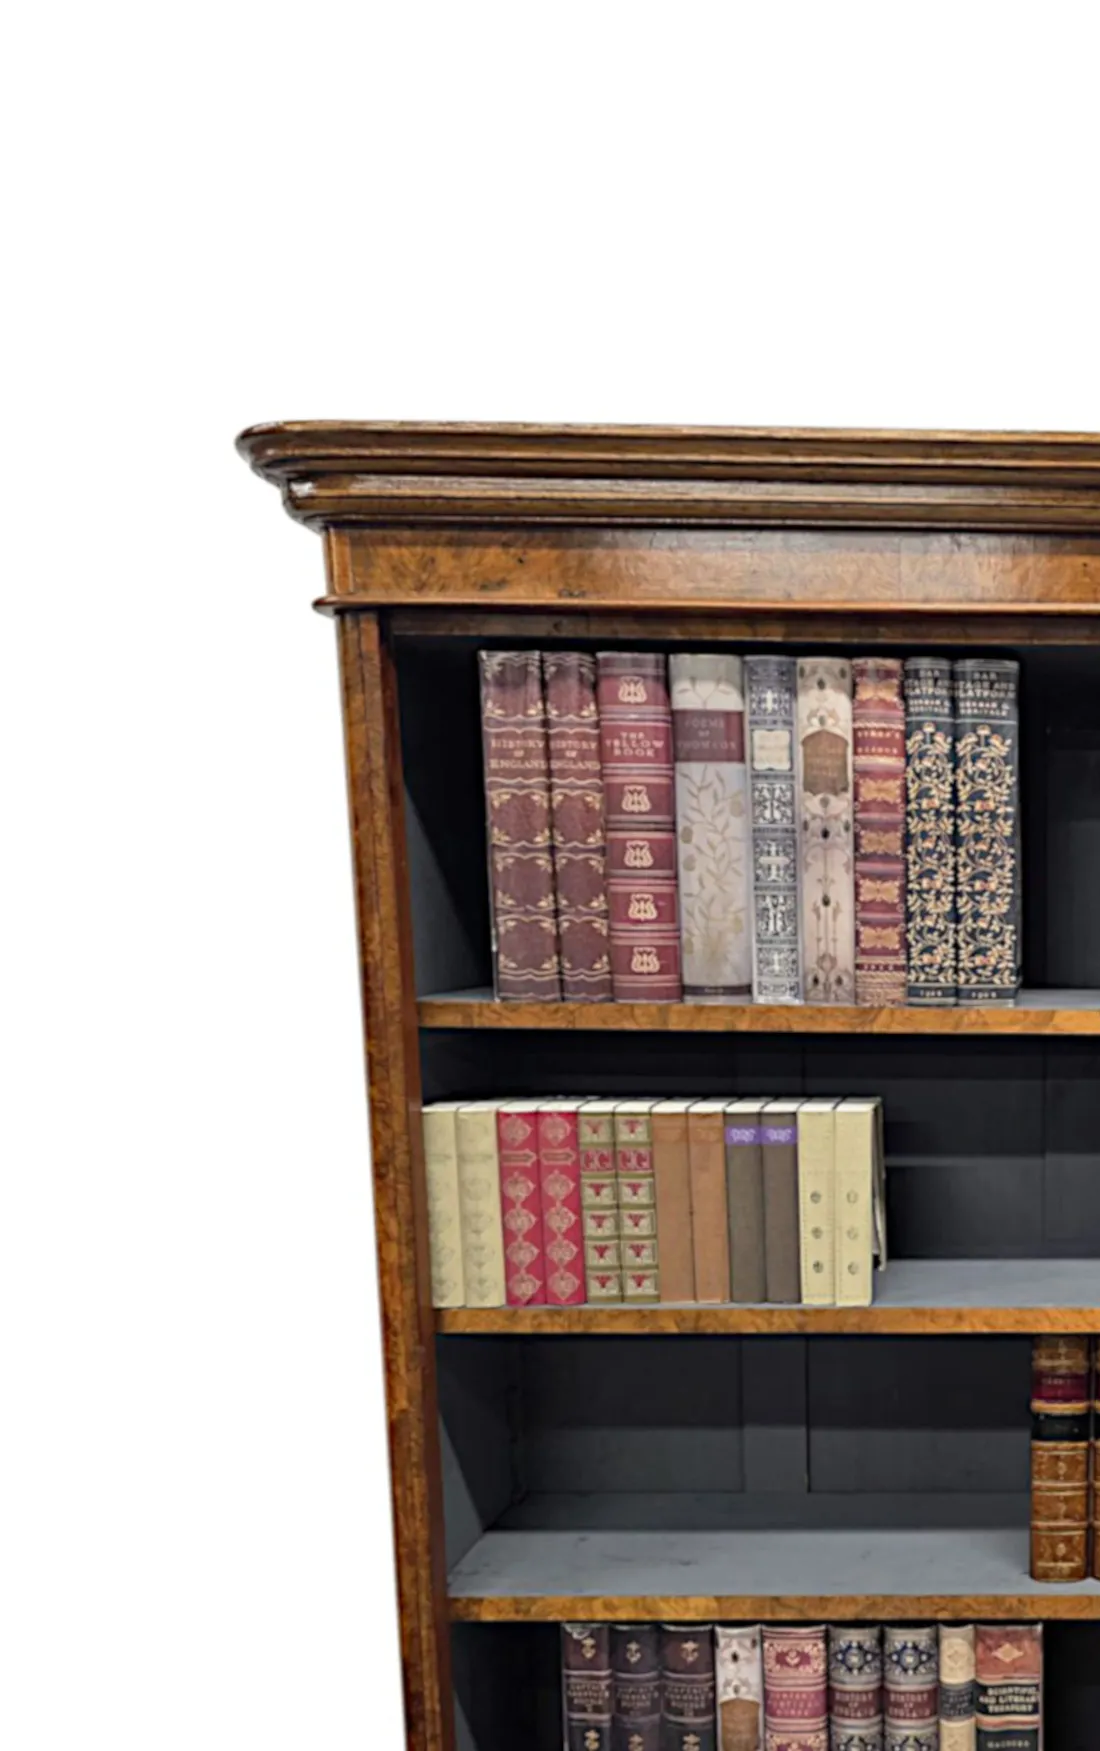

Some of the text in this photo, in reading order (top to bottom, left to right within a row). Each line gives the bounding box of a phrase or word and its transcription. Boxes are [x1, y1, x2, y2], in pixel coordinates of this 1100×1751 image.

[619, 731, 645, 740] THE
[604, 739, 665, 749] YELLOW
[613, 748, 656, 758] BOOK
